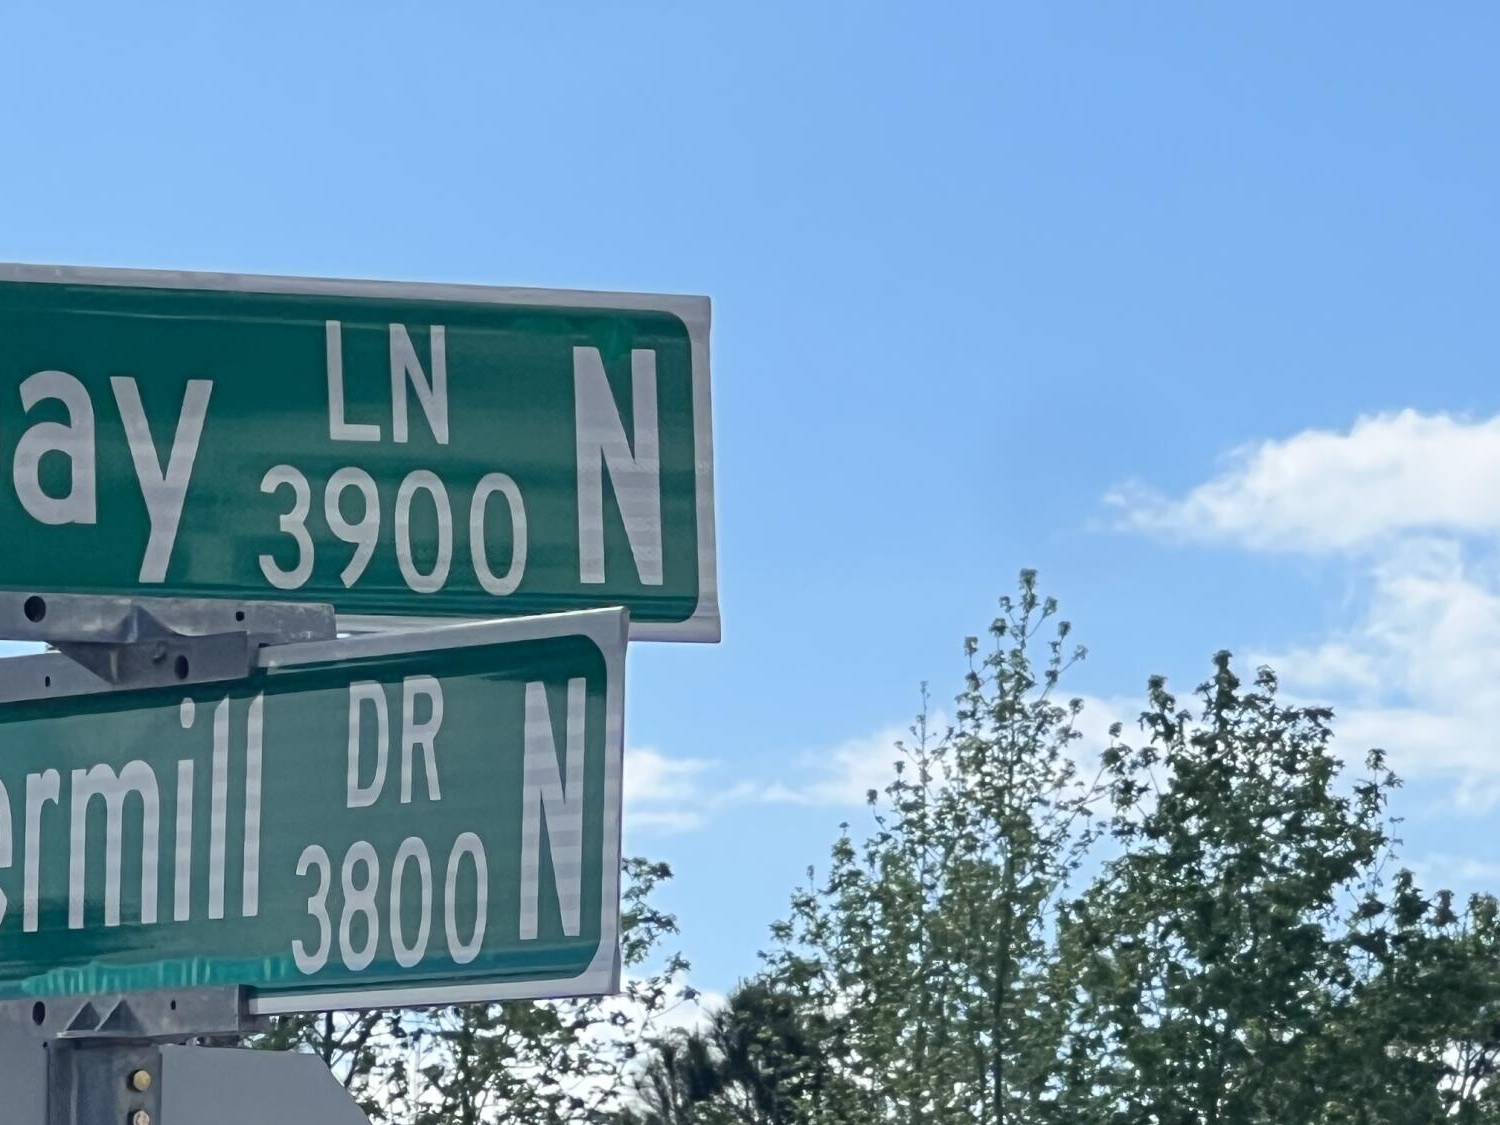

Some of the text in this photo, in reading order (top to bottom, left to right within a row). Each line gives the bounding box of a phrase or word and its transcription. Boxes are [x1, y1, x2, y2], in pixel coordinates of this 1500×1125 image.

[258, 463, 528, 596] 3900
[326, 320, 449, 445] LN
[572, 345, 663, 586] N
[291, 831, 489, 975] 3800
[347, 674, 444, 809] DR
[519, 676, 587, 940] N
